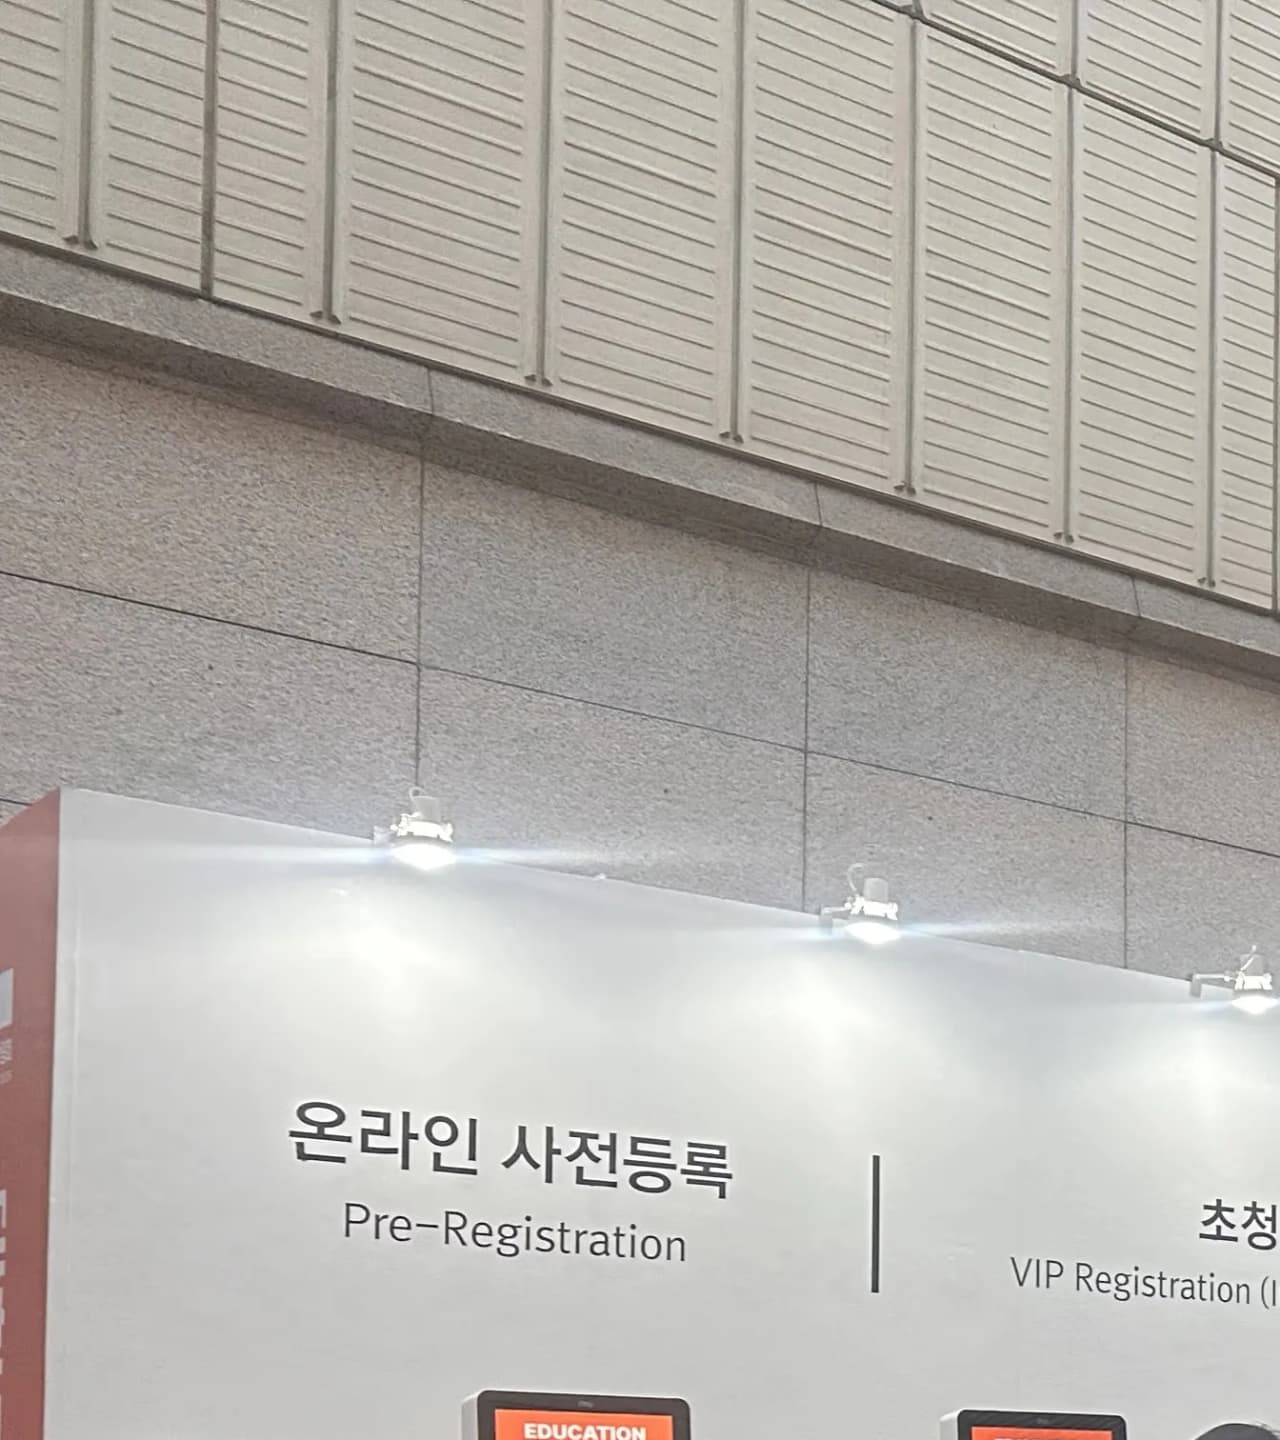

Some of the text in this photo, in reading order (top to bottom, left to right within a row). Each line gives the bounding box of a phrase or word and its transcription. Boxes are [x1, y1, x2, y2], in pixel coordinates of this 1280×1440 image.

[288, 1101, 734, 1200] 온라인 사전등록
[343, 1202, 687, 1263] Pre-Registration
[1010, 1256, 1064, 1289] VIP
[1075, 1262, 1251, 1306] Registration
